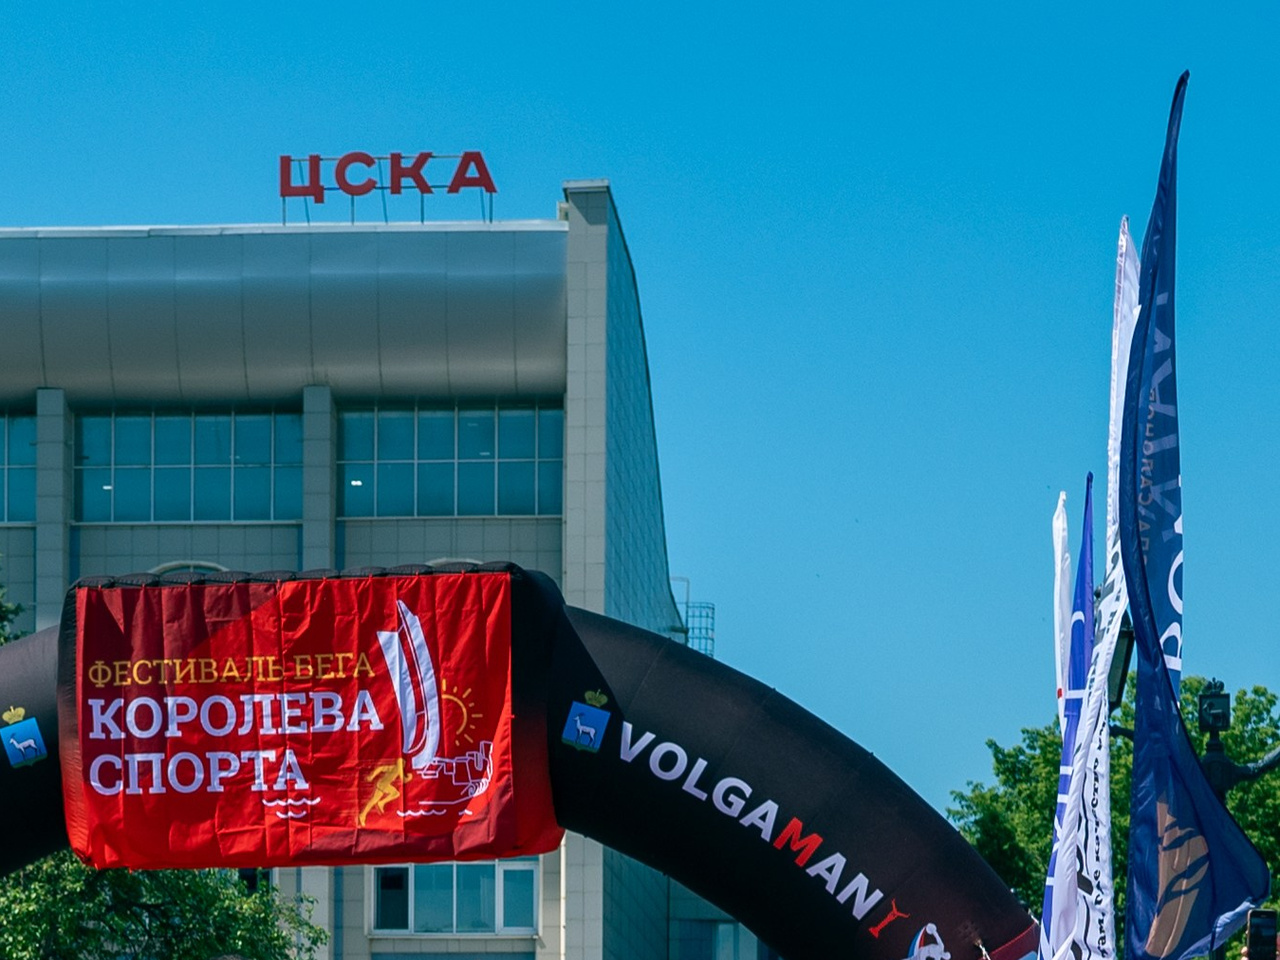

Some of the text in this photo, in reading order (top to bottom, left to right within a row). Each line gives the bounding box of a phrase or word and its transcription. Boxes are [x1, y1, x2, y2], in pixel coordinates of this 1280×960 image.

[279, 151, 498, 204] ЦСКА
[88, 652, 376, 688] ФЕСТИВАЛЬ БЕГА
[88, 690, 384, 741] КОРОЛЕВА
[88, 749, 309, 796] СПОРТА
